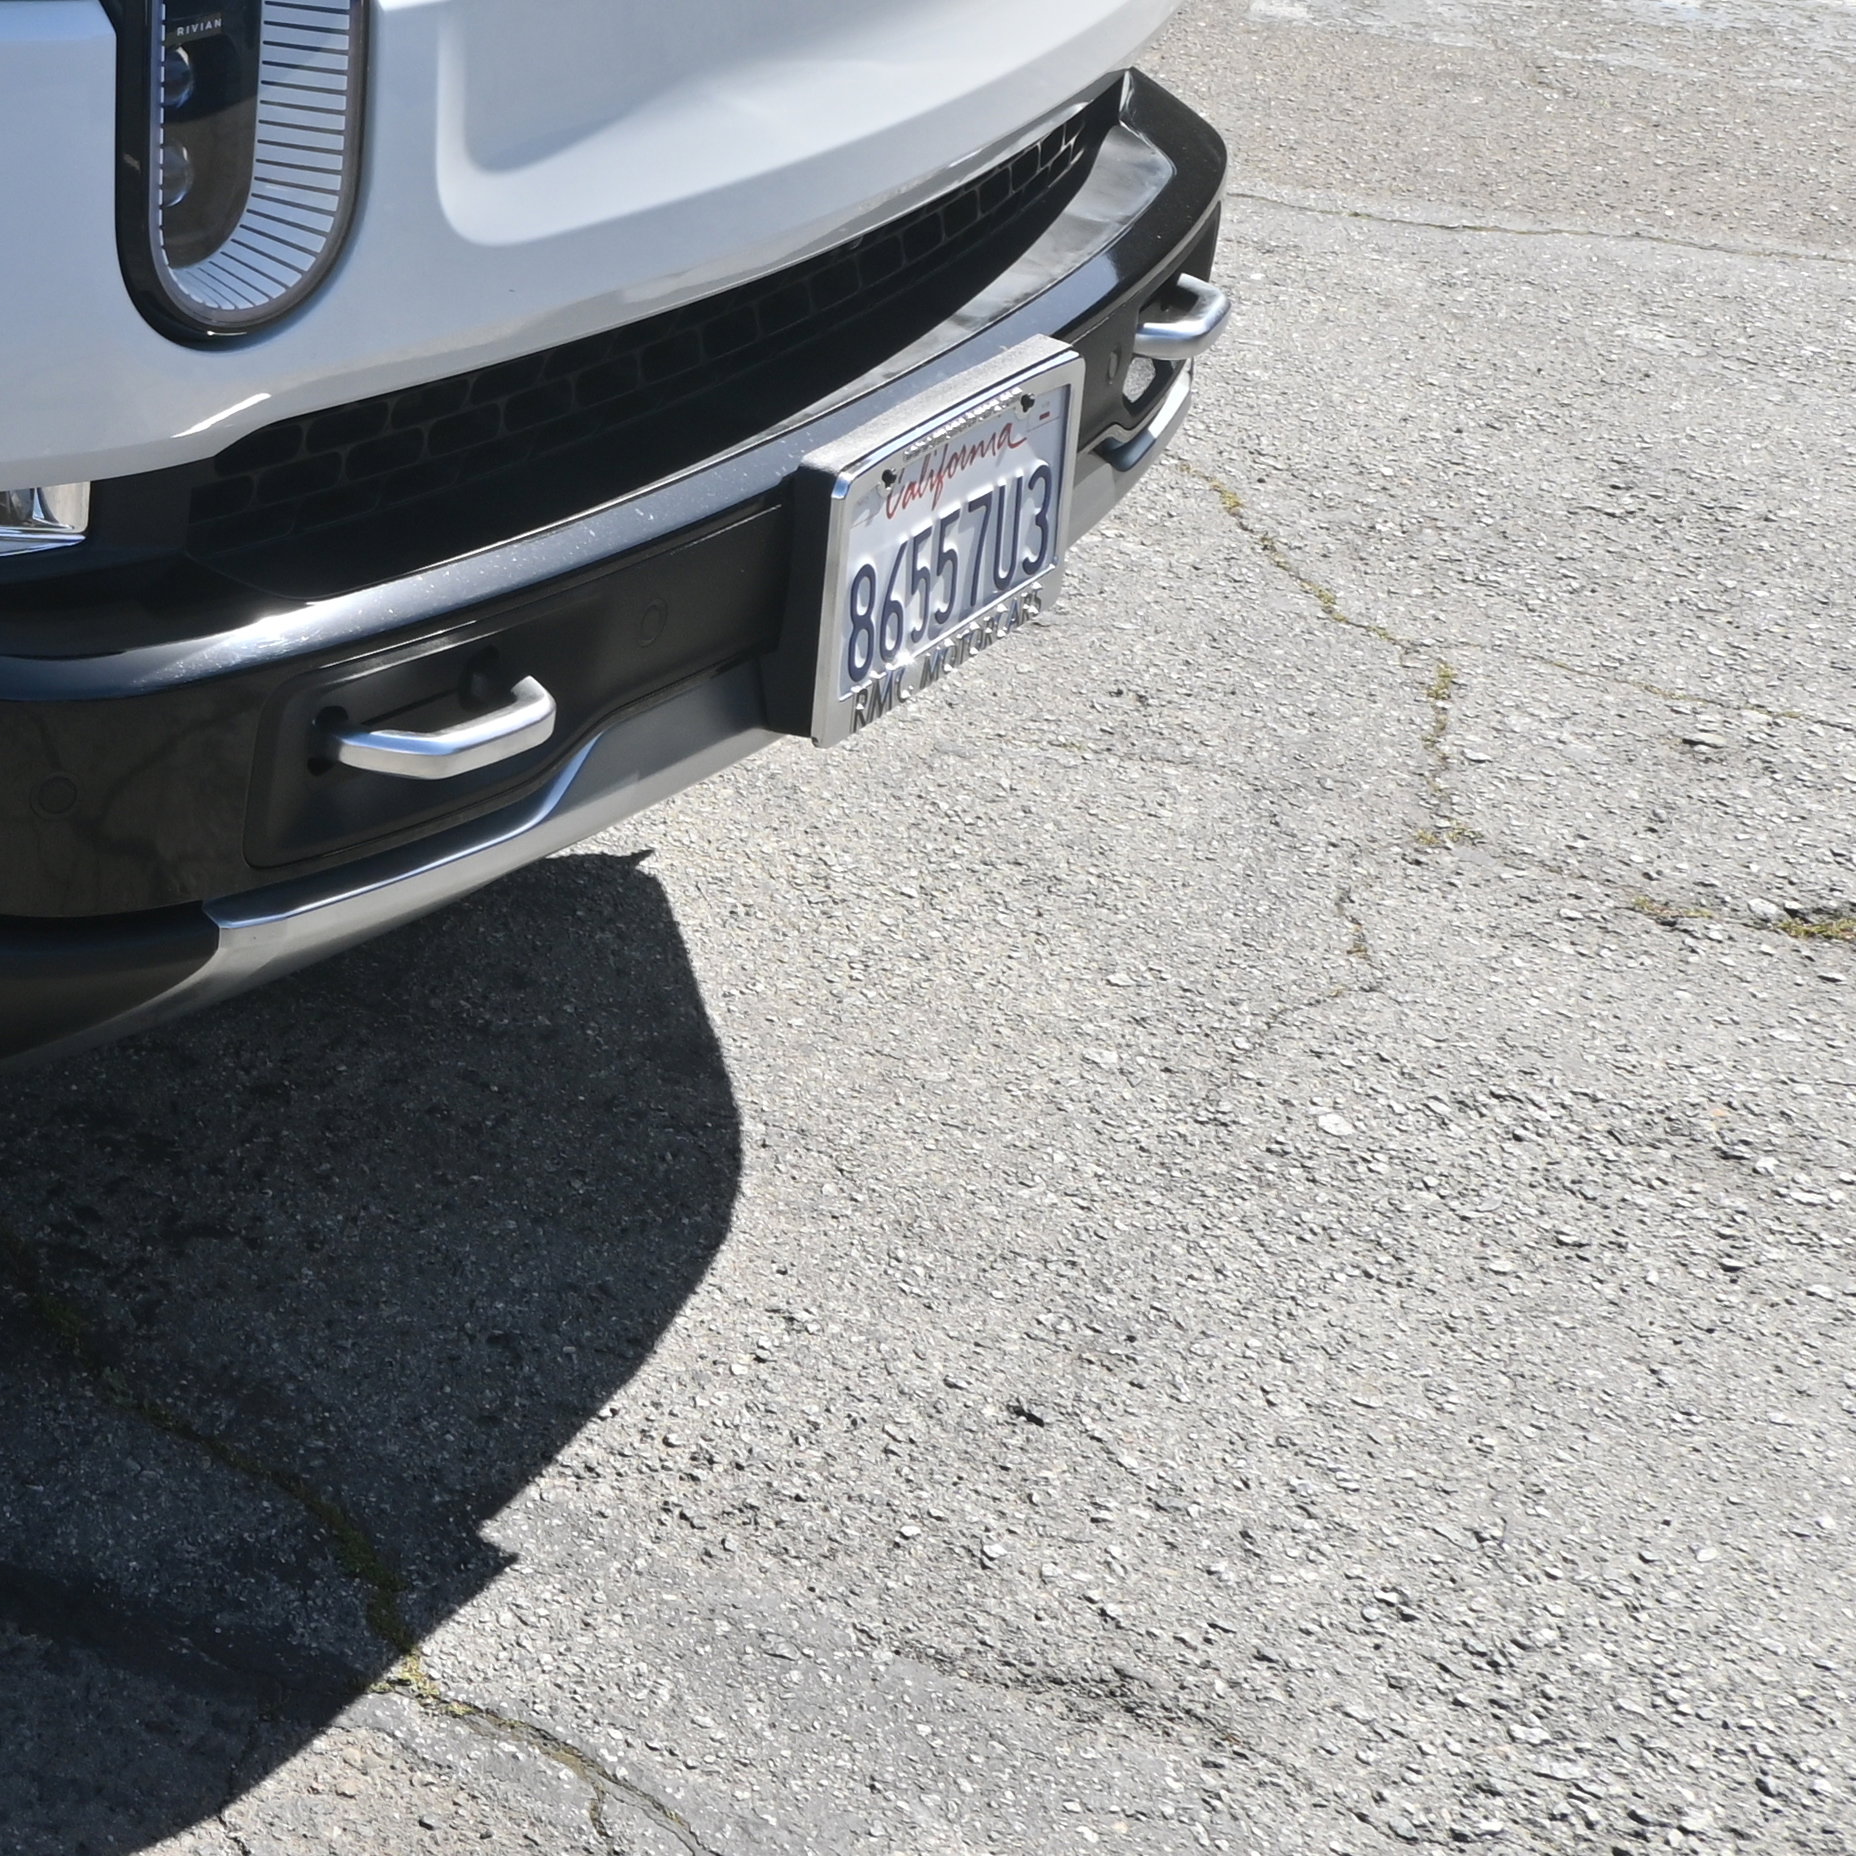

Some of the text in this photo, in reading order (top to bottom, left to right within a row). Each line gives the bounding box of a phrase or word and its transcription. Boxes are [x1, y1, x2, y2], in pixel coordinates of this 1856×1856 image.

[176, 18, 223, 37] RIVIAN
[886, 422, 1027, 520] California
[847, 464, 1054, 683] 86557U3
[919, 581, 1043, 691] MOTORCARS
